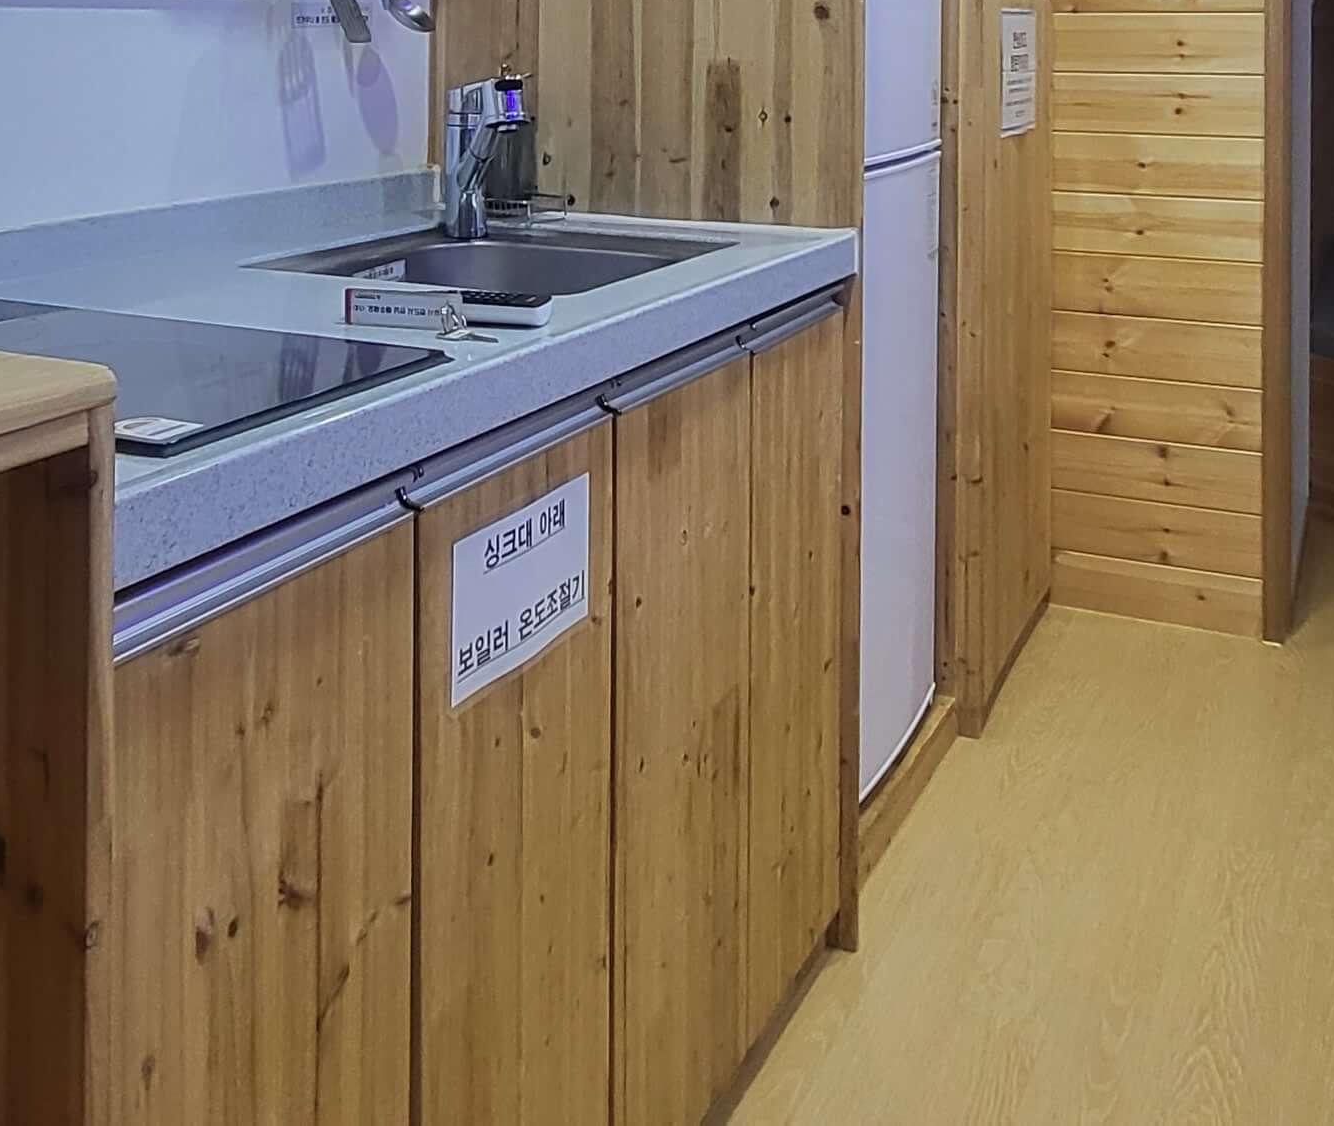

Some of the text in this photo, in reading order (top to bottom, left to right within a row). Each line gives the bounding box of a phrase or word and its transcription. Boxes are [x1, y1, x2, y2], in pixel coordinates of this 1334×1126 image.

[484, 498, 565, 568] 싱크대 아래
[458, 620, 509, 676] 보일러
